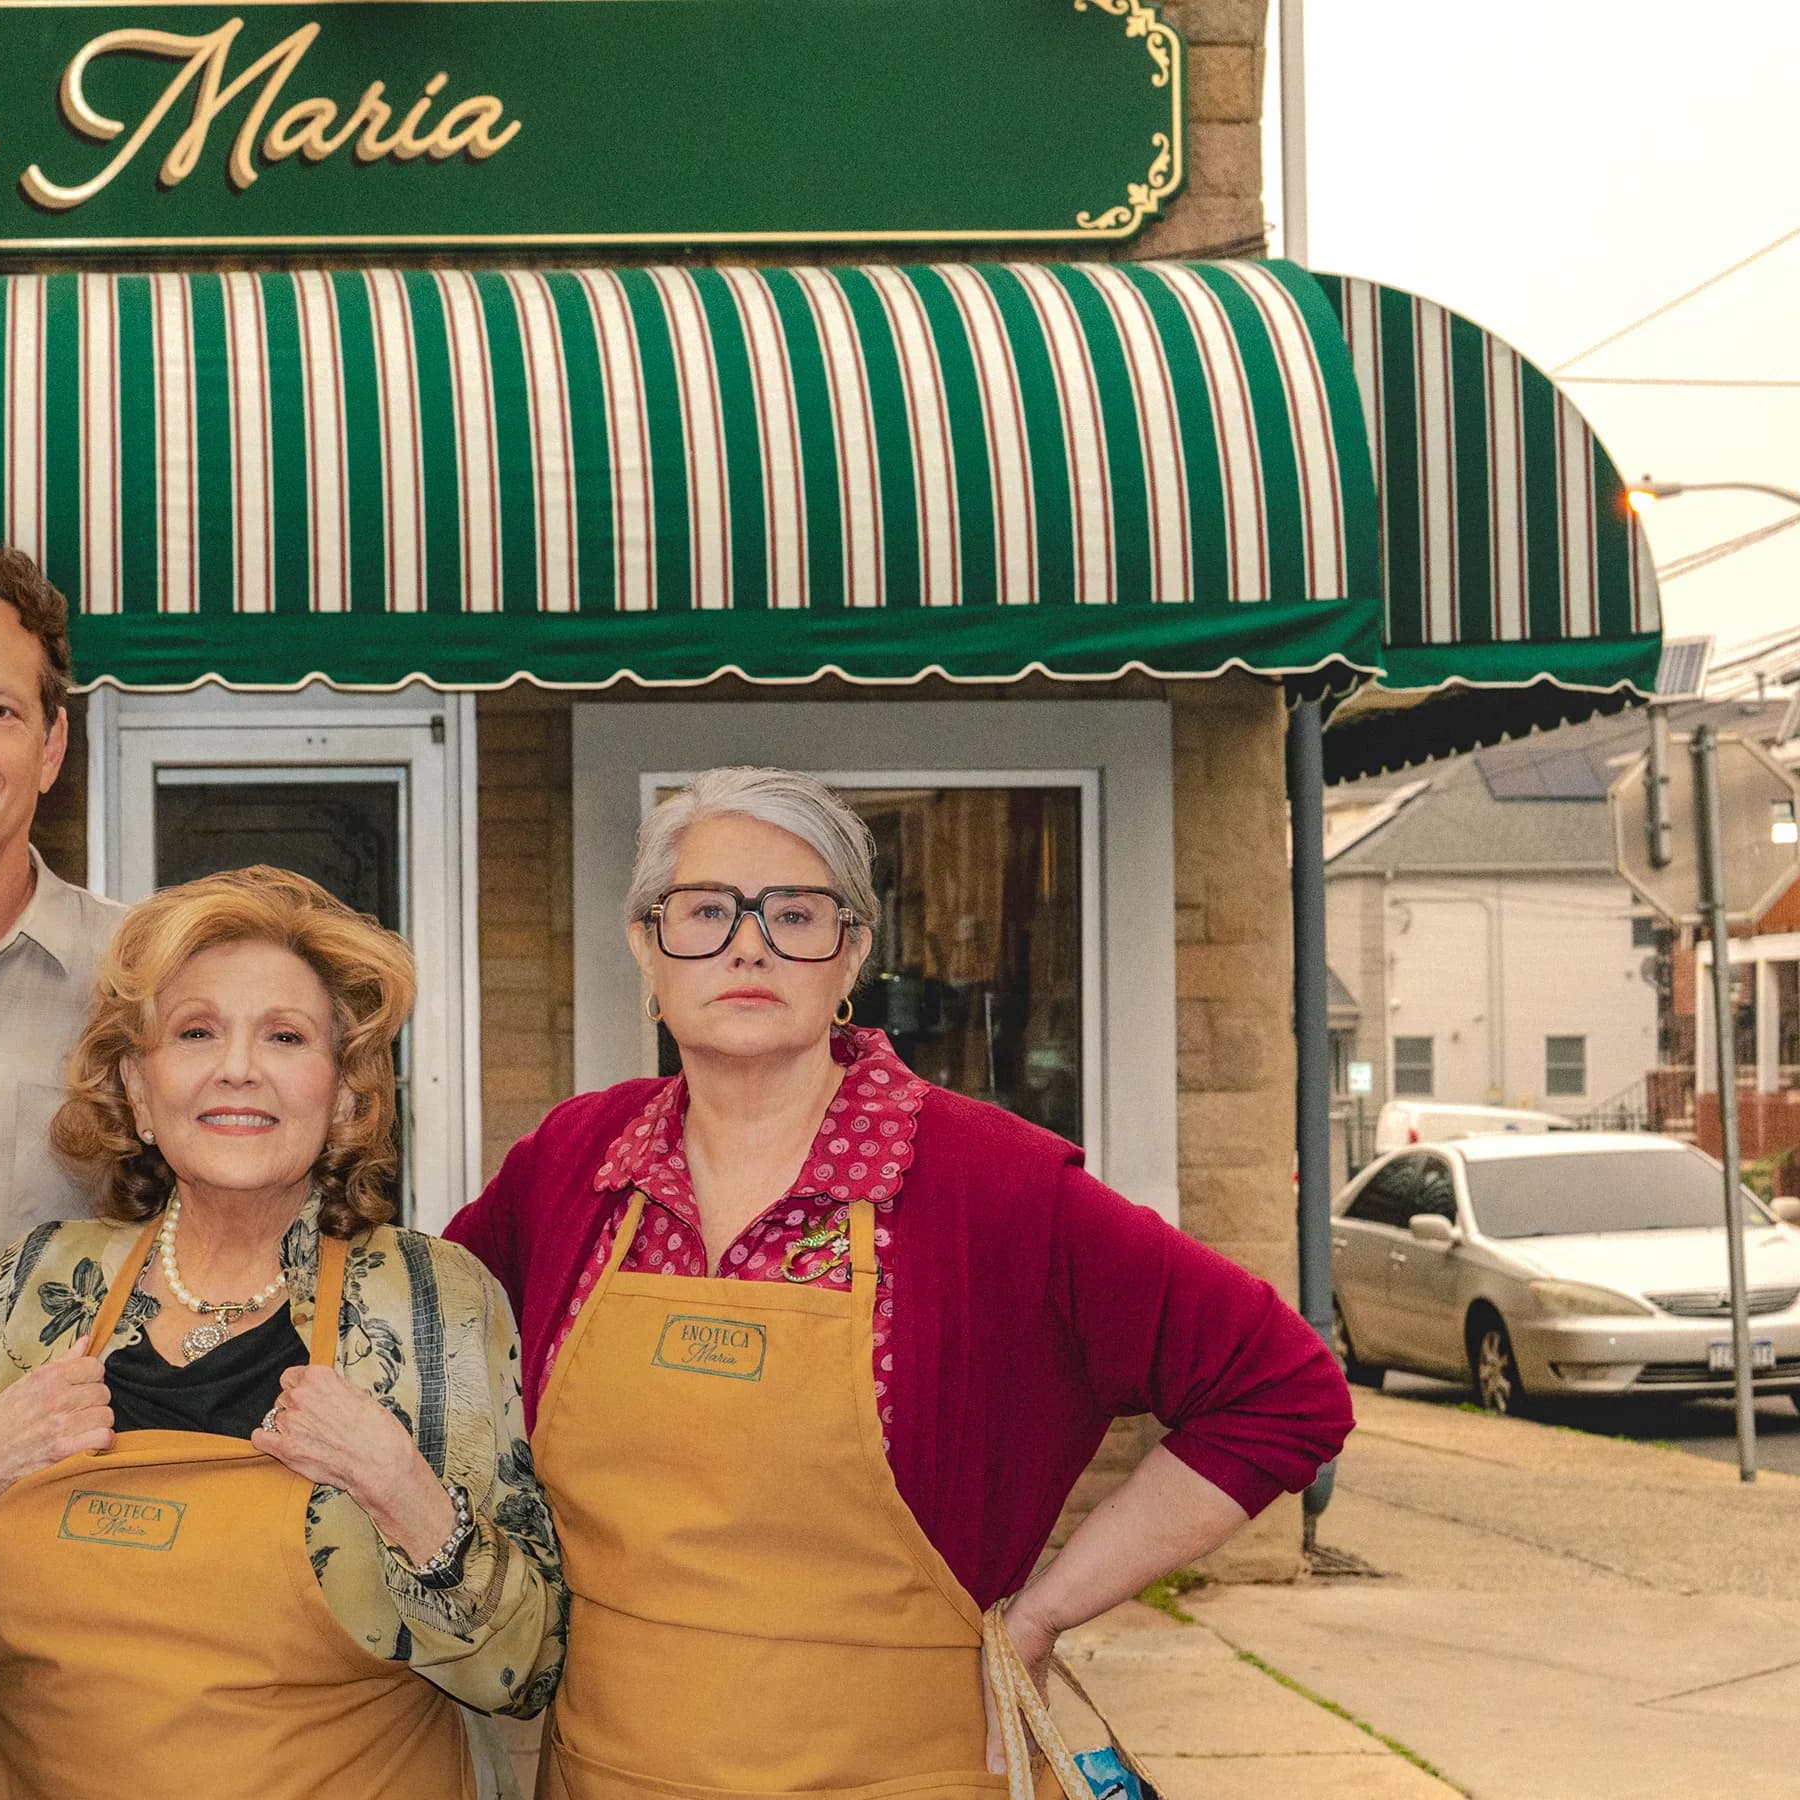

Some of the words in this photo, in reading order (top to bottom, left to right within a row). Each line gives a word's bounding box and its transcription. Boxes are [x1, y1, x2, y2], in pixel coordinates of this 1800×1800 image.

[19, 17, 521, 209] Maria
[681, 1325, 749, 1348] ENOTECA
[681, 1342, 737, 1365] Maria
[88, 1500, 162, 1521] ENOTECA
[89, 1516, 147, 1536] Maria
